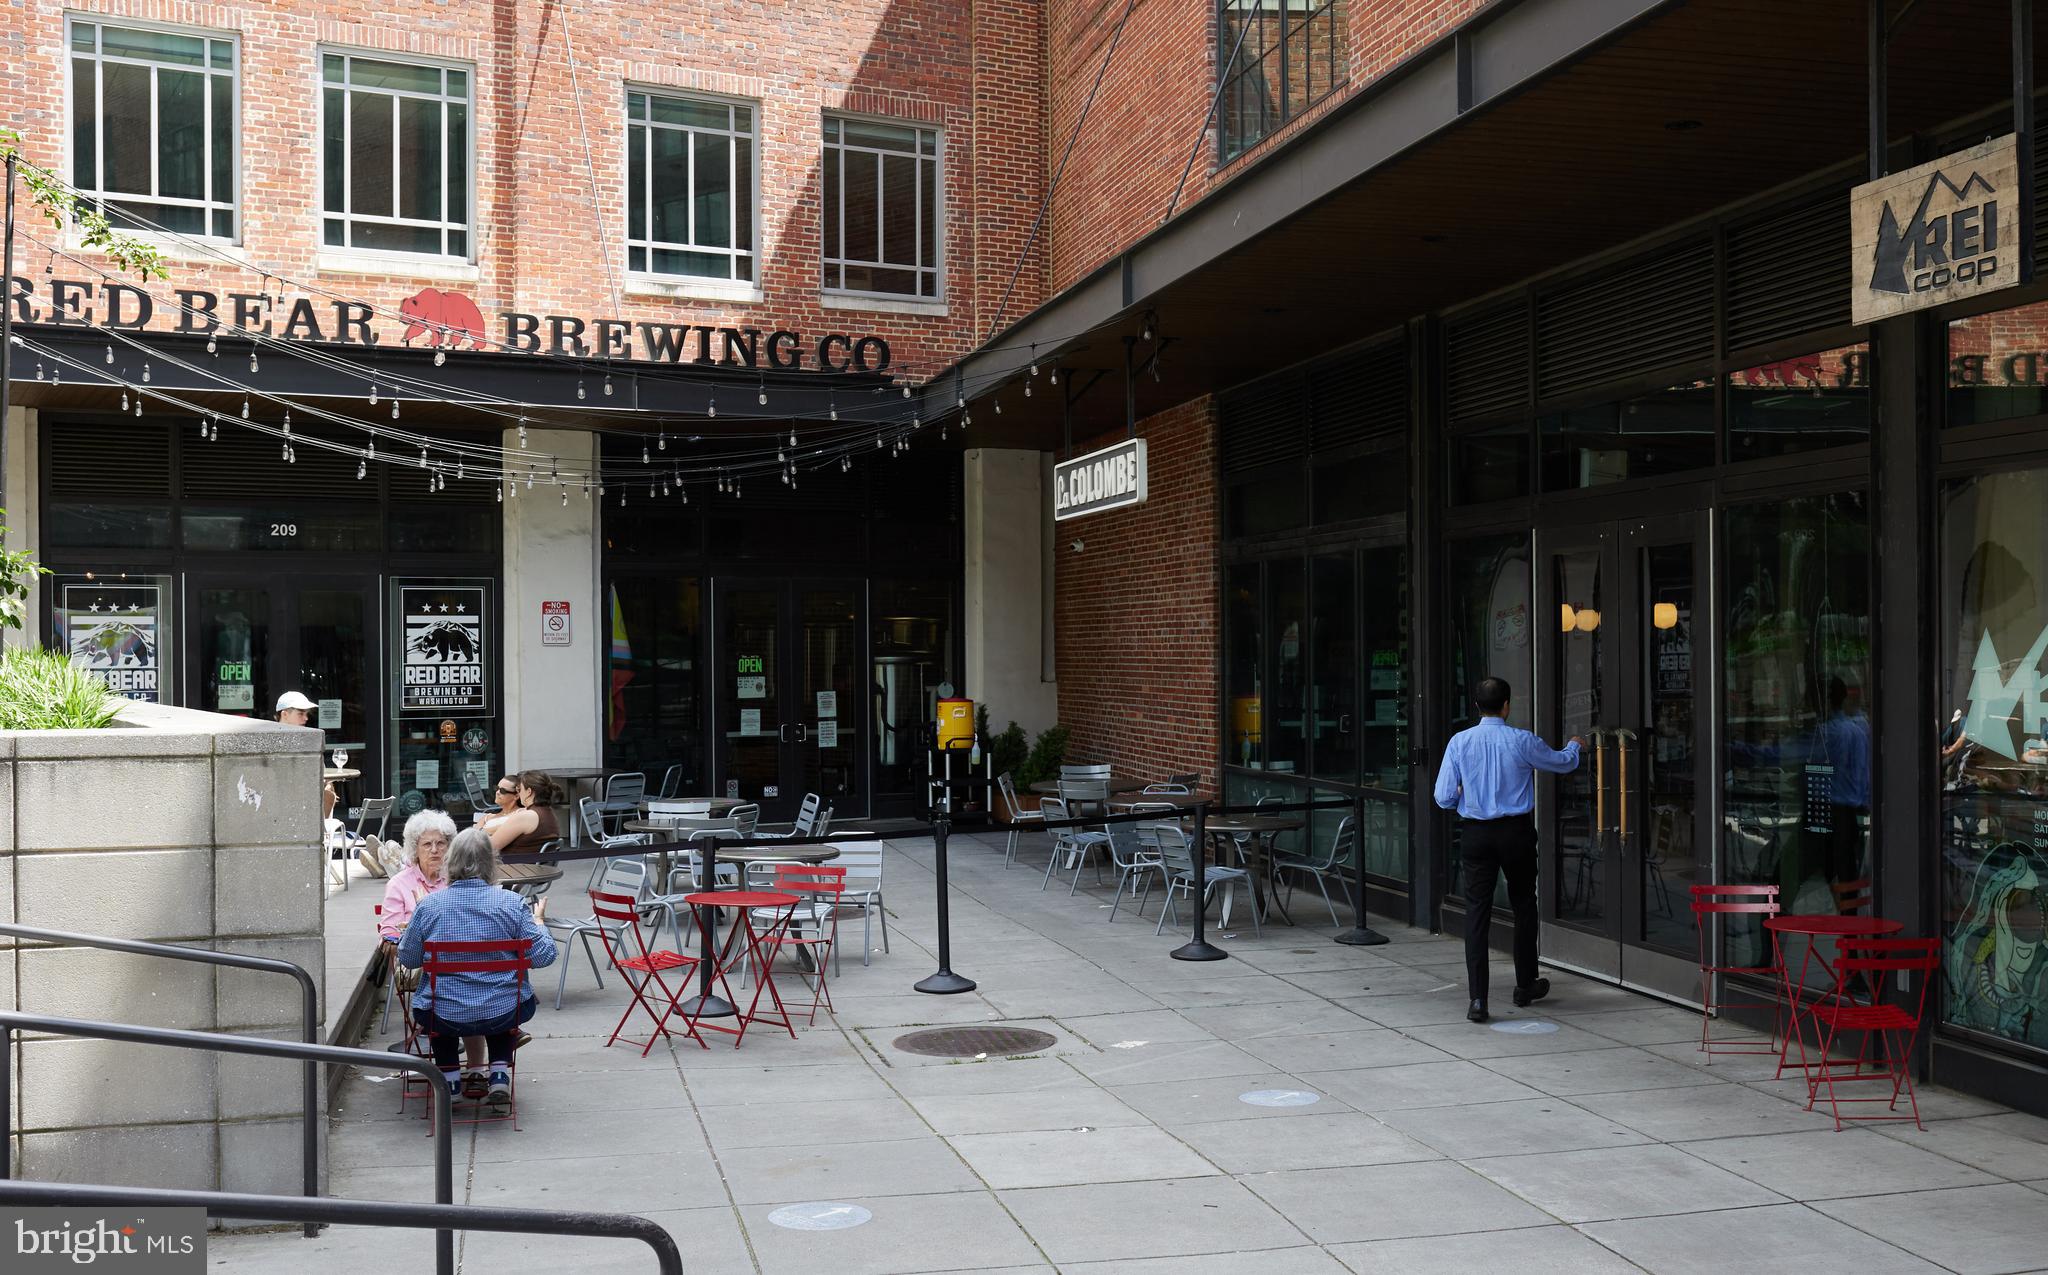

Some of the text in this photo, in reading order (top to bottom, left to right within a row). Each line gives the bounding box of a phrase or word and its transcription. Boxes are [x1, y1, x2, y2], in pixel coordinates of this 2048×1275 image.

[1914, 200, 1998, 271] REI
[0, 274, 892, 375] RED BEAR BREWING CO
[1069, 451, 1136, 507] COLOMBE
[271, 524, 297, 536] 209
[220, 664, 251, 681] OPEN
[738, 658, 763, 673] OPEN
[109, 670, 157, 690] BEAR
[405, 665, 481, 684] RED BEAR
[414, 687, 473, 696] BREWING CO
[419, 697, 469, 705] WASHINGTON
[2034, 809, 2048, 820] MO
